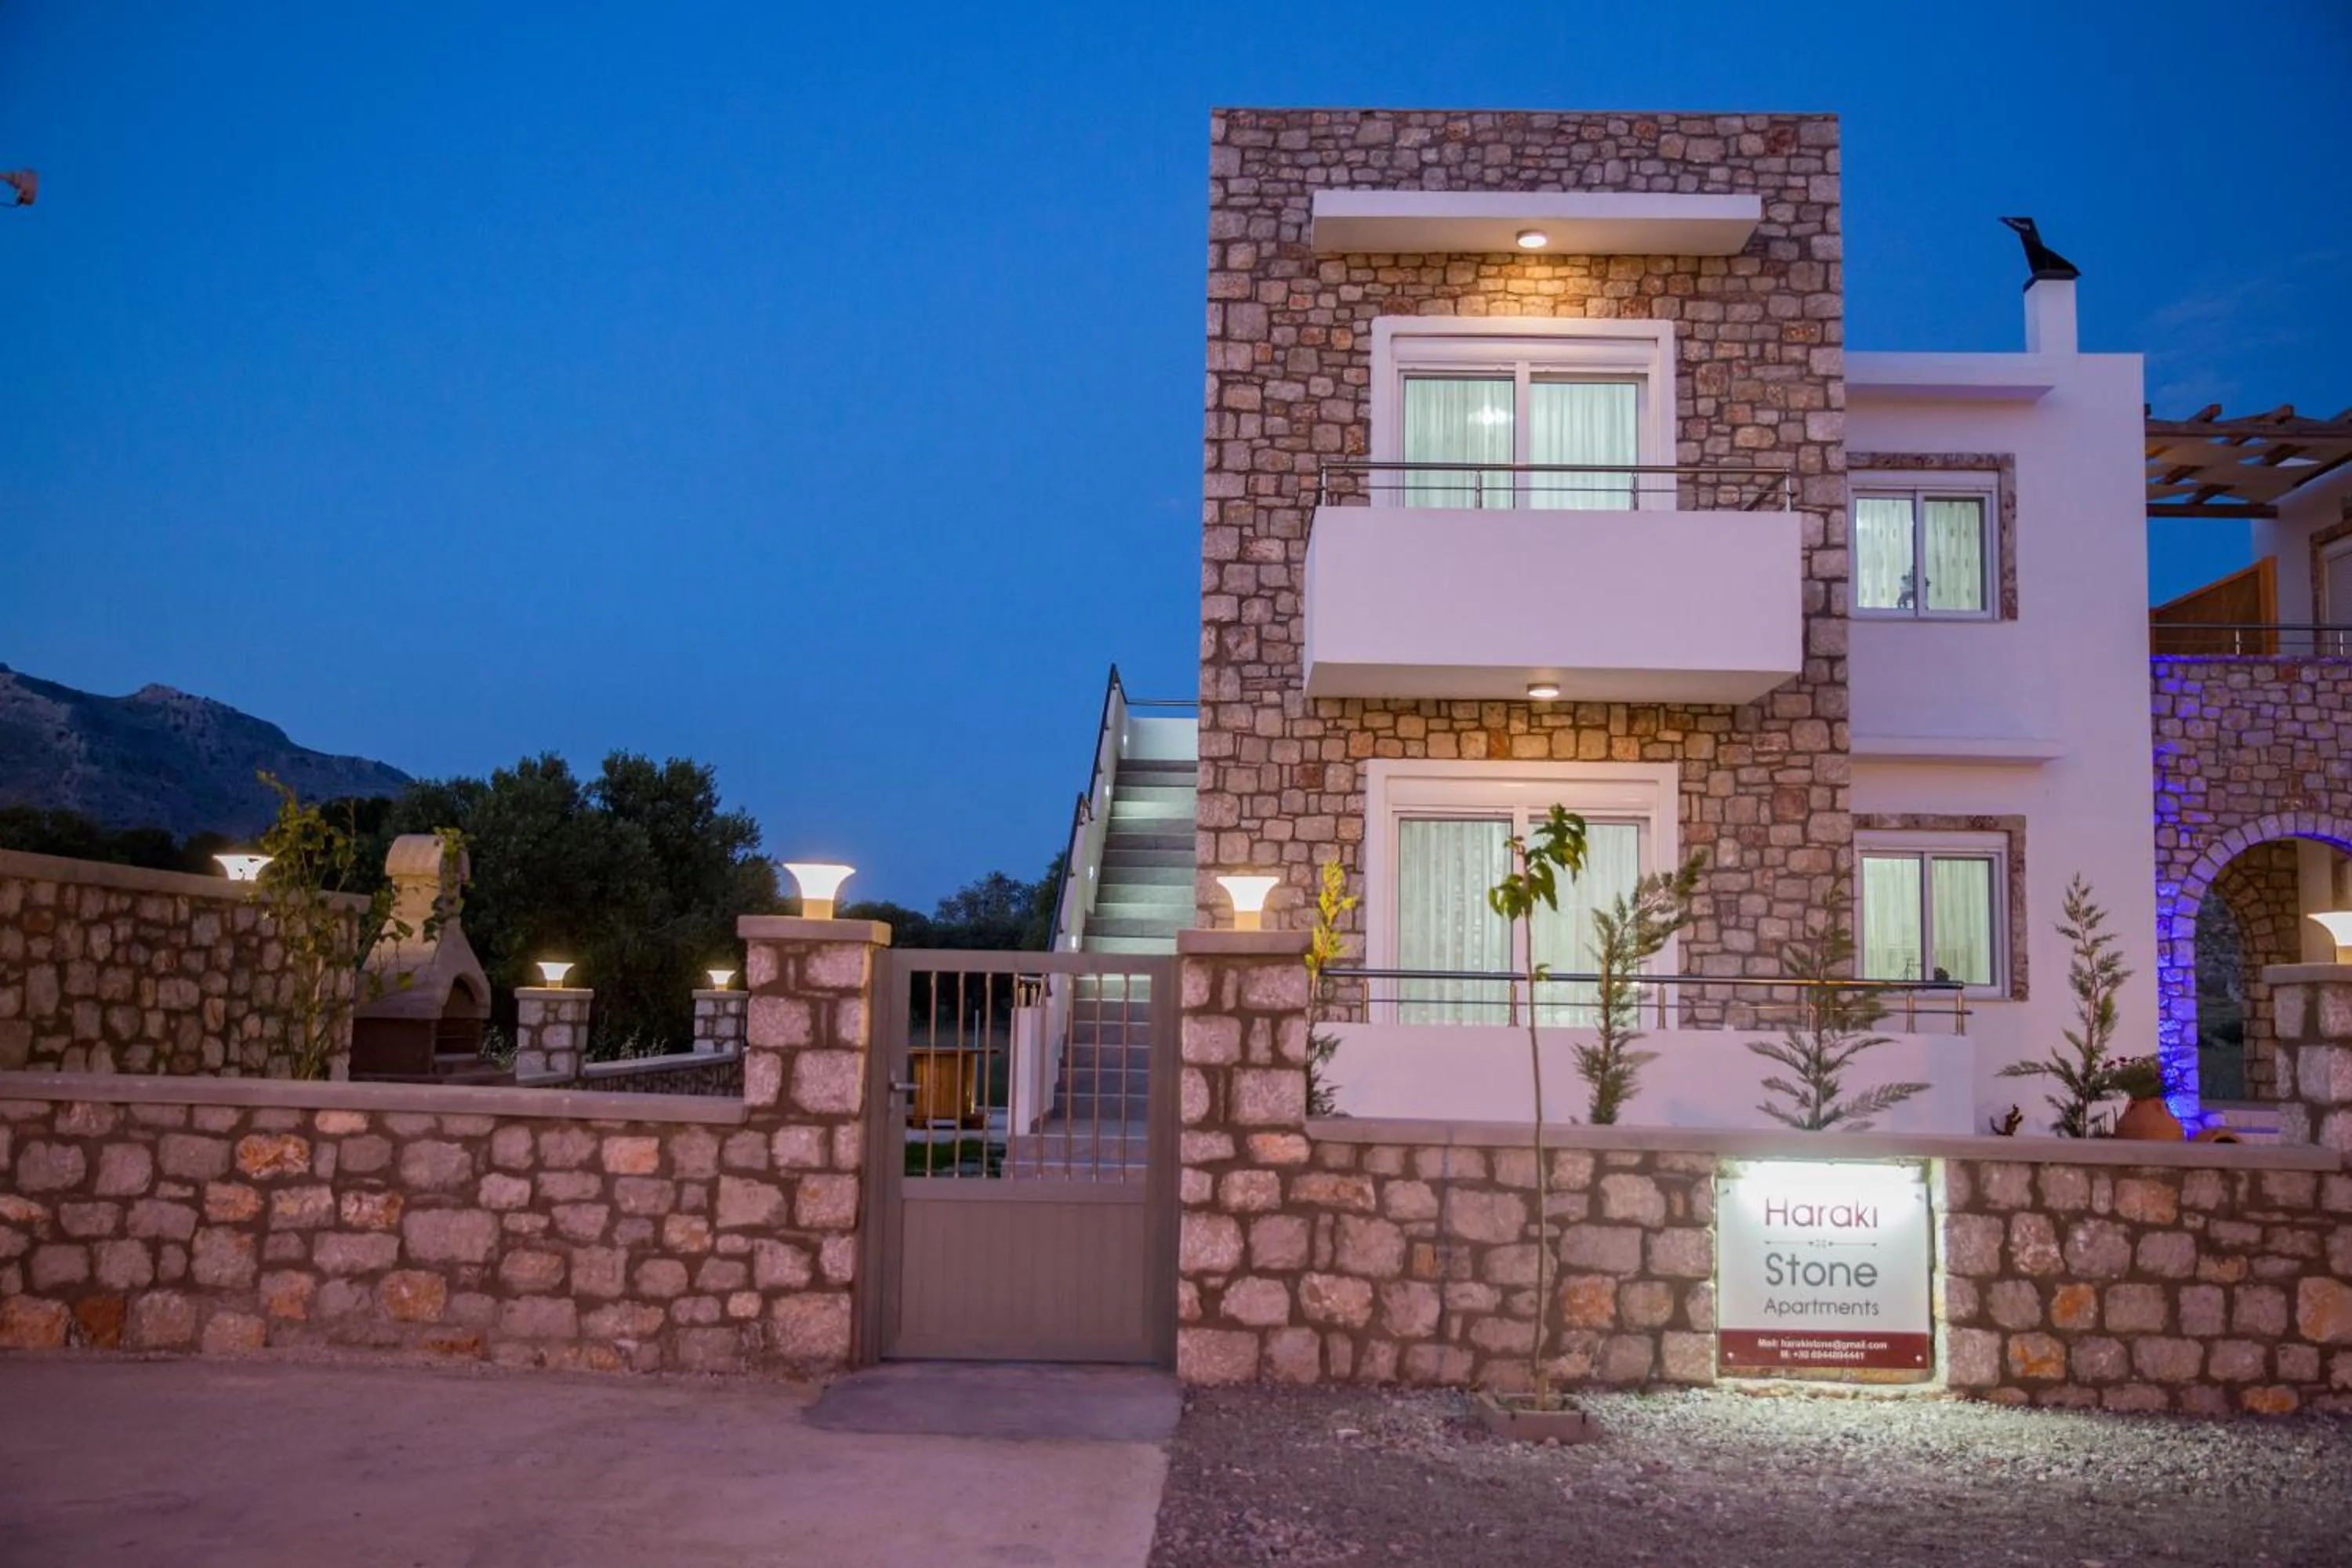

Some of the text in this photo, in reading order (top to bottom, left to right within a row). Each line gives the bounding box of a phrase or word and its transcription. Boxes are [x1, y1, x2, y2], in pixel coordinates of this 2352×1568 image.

[1765, 1196, 1878, 1228] Haraki
[1765, 1252, 1878, 1287] Stone
[1764, 1298, 1879, 1316] Apartments
